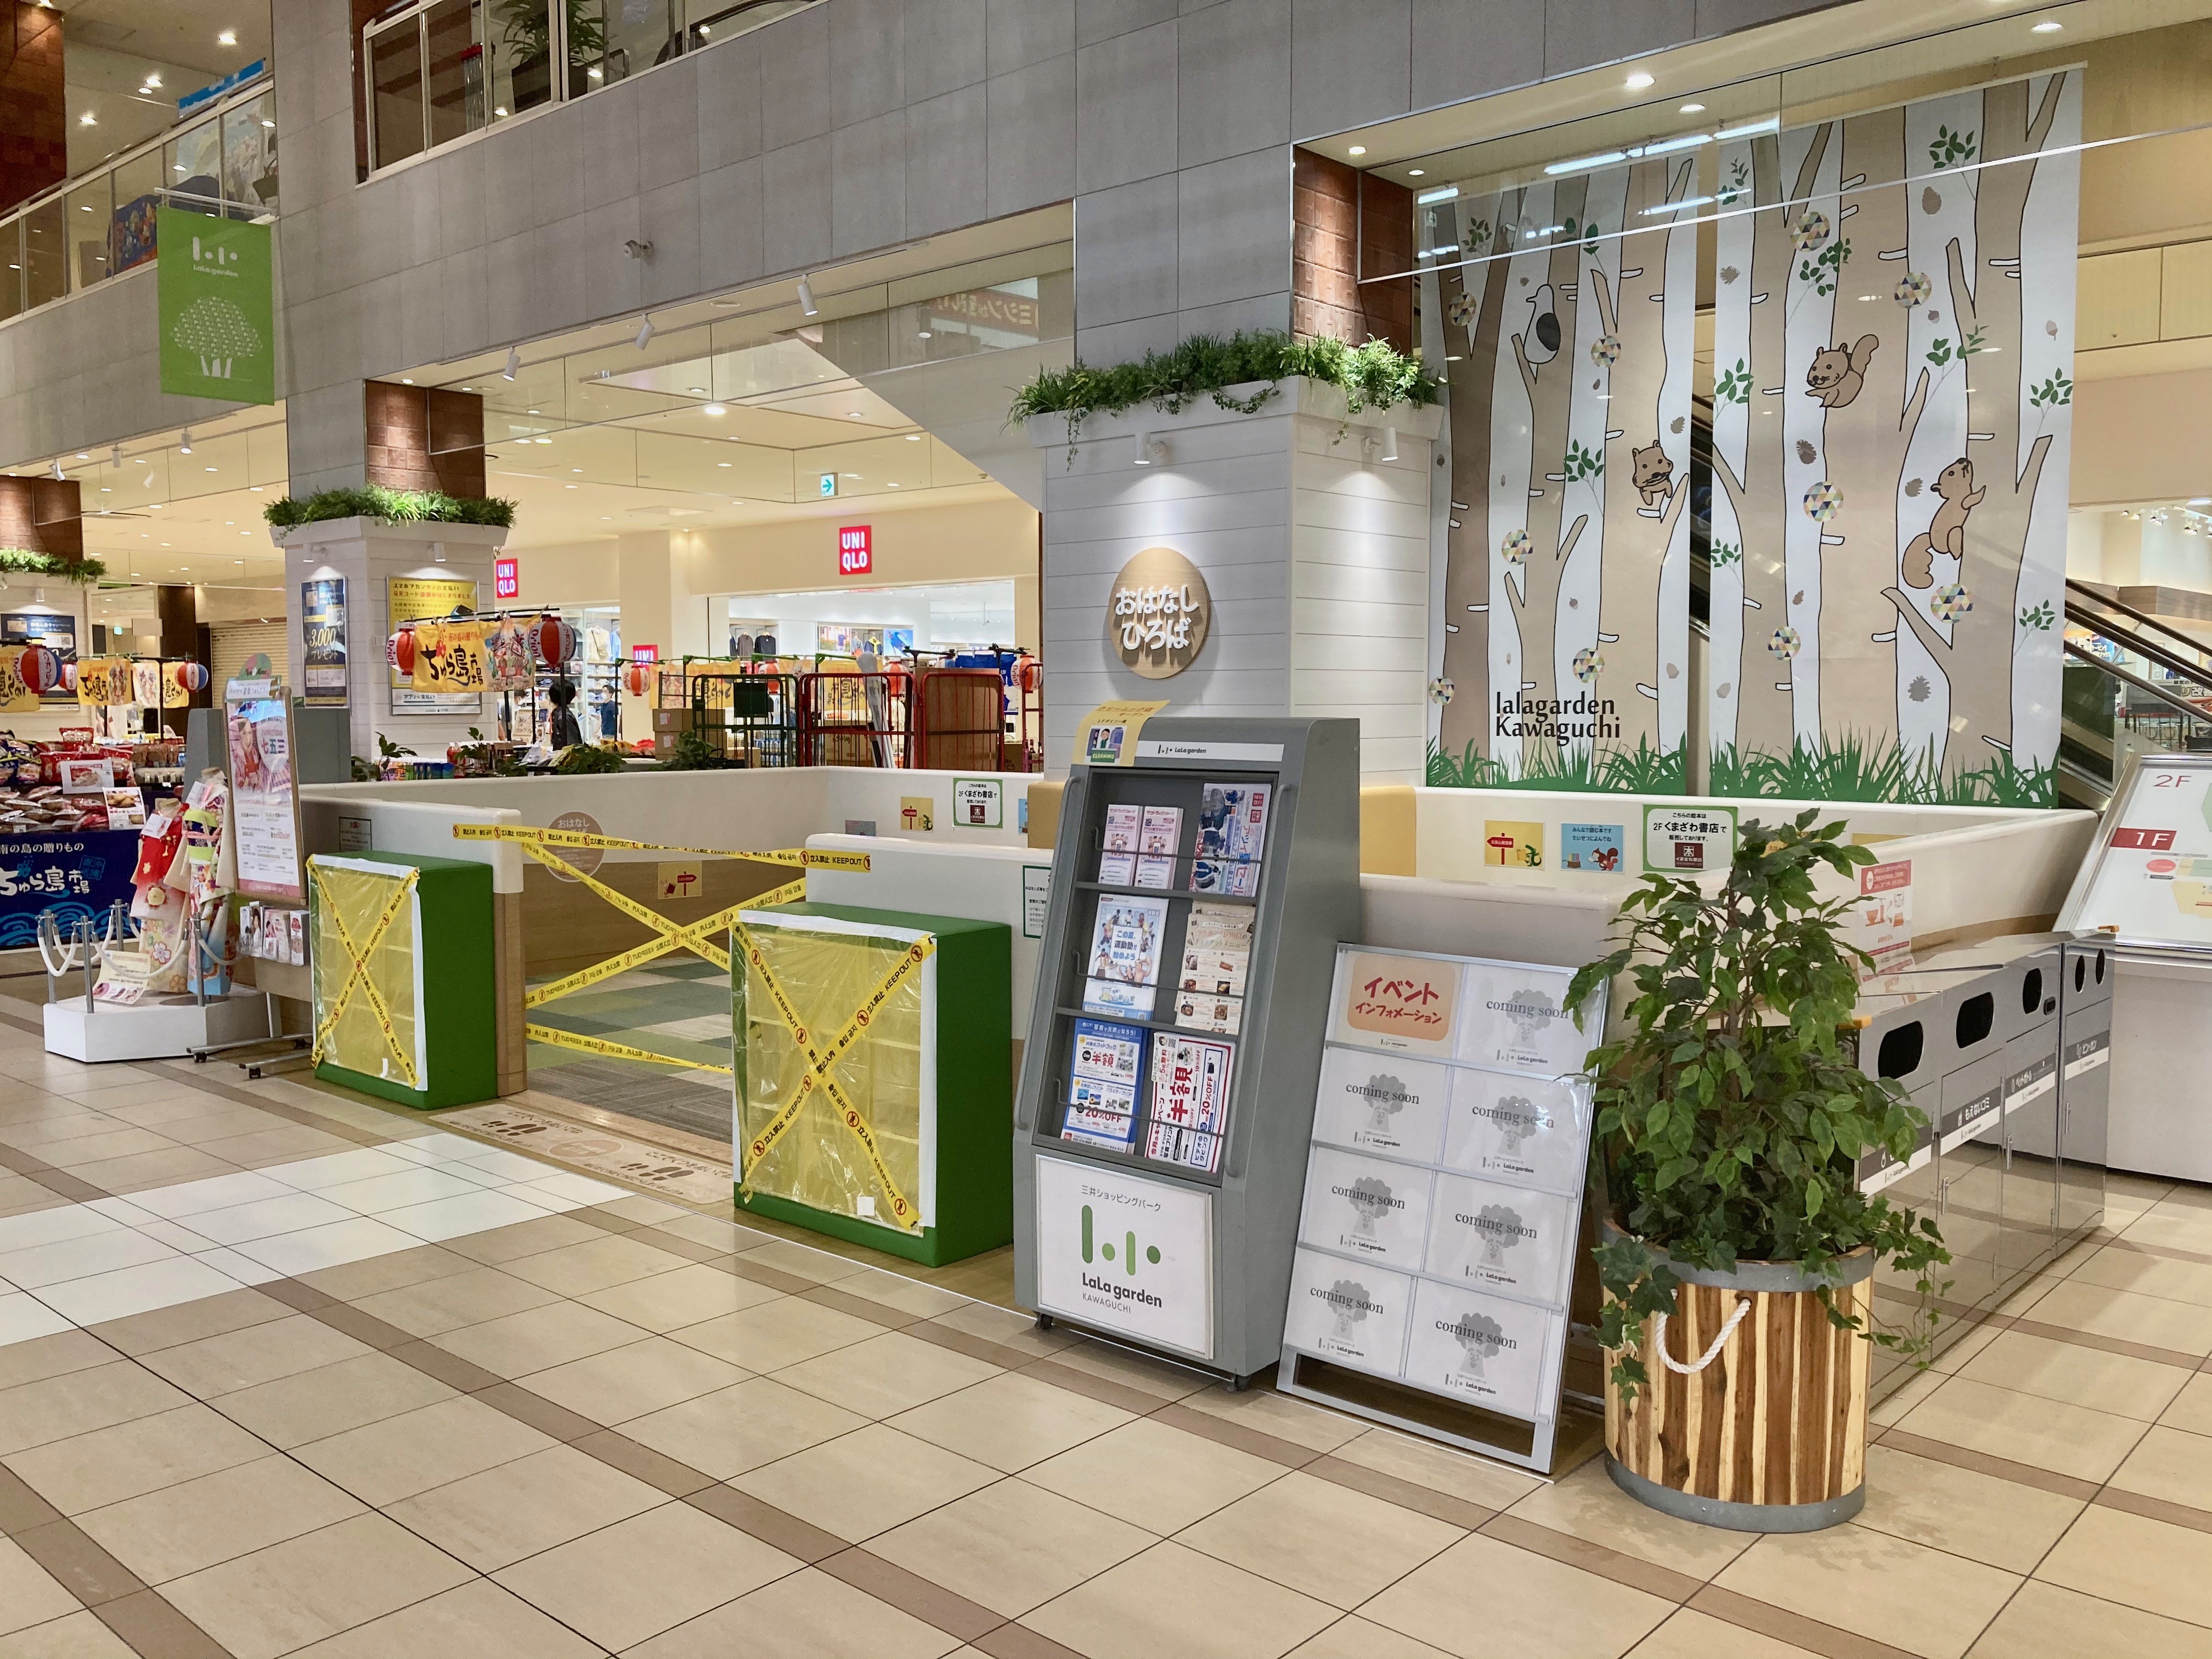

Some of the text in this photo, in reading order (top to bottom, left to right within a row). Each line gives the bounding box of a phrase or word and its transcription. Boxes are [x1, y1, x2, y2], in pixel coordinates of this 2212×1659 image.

[842, 531, 865, 550] UNI
[498, 563, 513, 578] UNI
[842, 551, 868, 572] QLO
[498, 579, 515, 597] QLO
[1115, 585, 1200, 616] おはなし
[309, 628, 336, 648] 3,000
[530, 629, 541, 658] Orion
[1121, 617, 1192, 650] ひろば
[311, 648, 338, 660] プレゼント
[387, 640, 396, 665] Orion
[1497, 691, 1615, 723] lalagarden
[1496, 714, 1620, 746] Kawaguchi
[261, 738, 286, 754] 七五三
[2153, 775, 2192, 788] 2F
[557, 818, 590, 828] おはなし
[2136, 832, 2170, 847] 1F
[810, 855, 830, 864] 立入禁止
[866, 991, 885, 1015] 立入禁止
[1364, 977, 1439, 1006] イベント
[1356, 1002, 1442, 1025] インフォメーション
[1486, 1000, 1568, 1019] coming soon
[1092, 1051, 1114, 1068] 半額
[1166, 1066, 1193, 1123] 半額
[1346, 1083, 1419, 1105] coming soon
[1086, 1105, 1122, 1123] 20%OFF
[1472, 1105, 1554, 1129] coming son
[764, 1120, 785, 1145] 立入禁止
[857, 1125, 875, 1155] 立入禁止
[1081, 1185, 1161, 1212] 三井ショッピングパーク
[1331, 1185, 1405, 1210] coming soon
[1455, 1212, 1537, 1239] coming soon
[1082, 1272, 1162, 1308] LaLa garden
[1310, 1286, 1384, 1314] coming soon
[1082, 1293, 1131, 1314] KAWAGUCHI
[1435, 1319, 1517, 1350] coming soon
